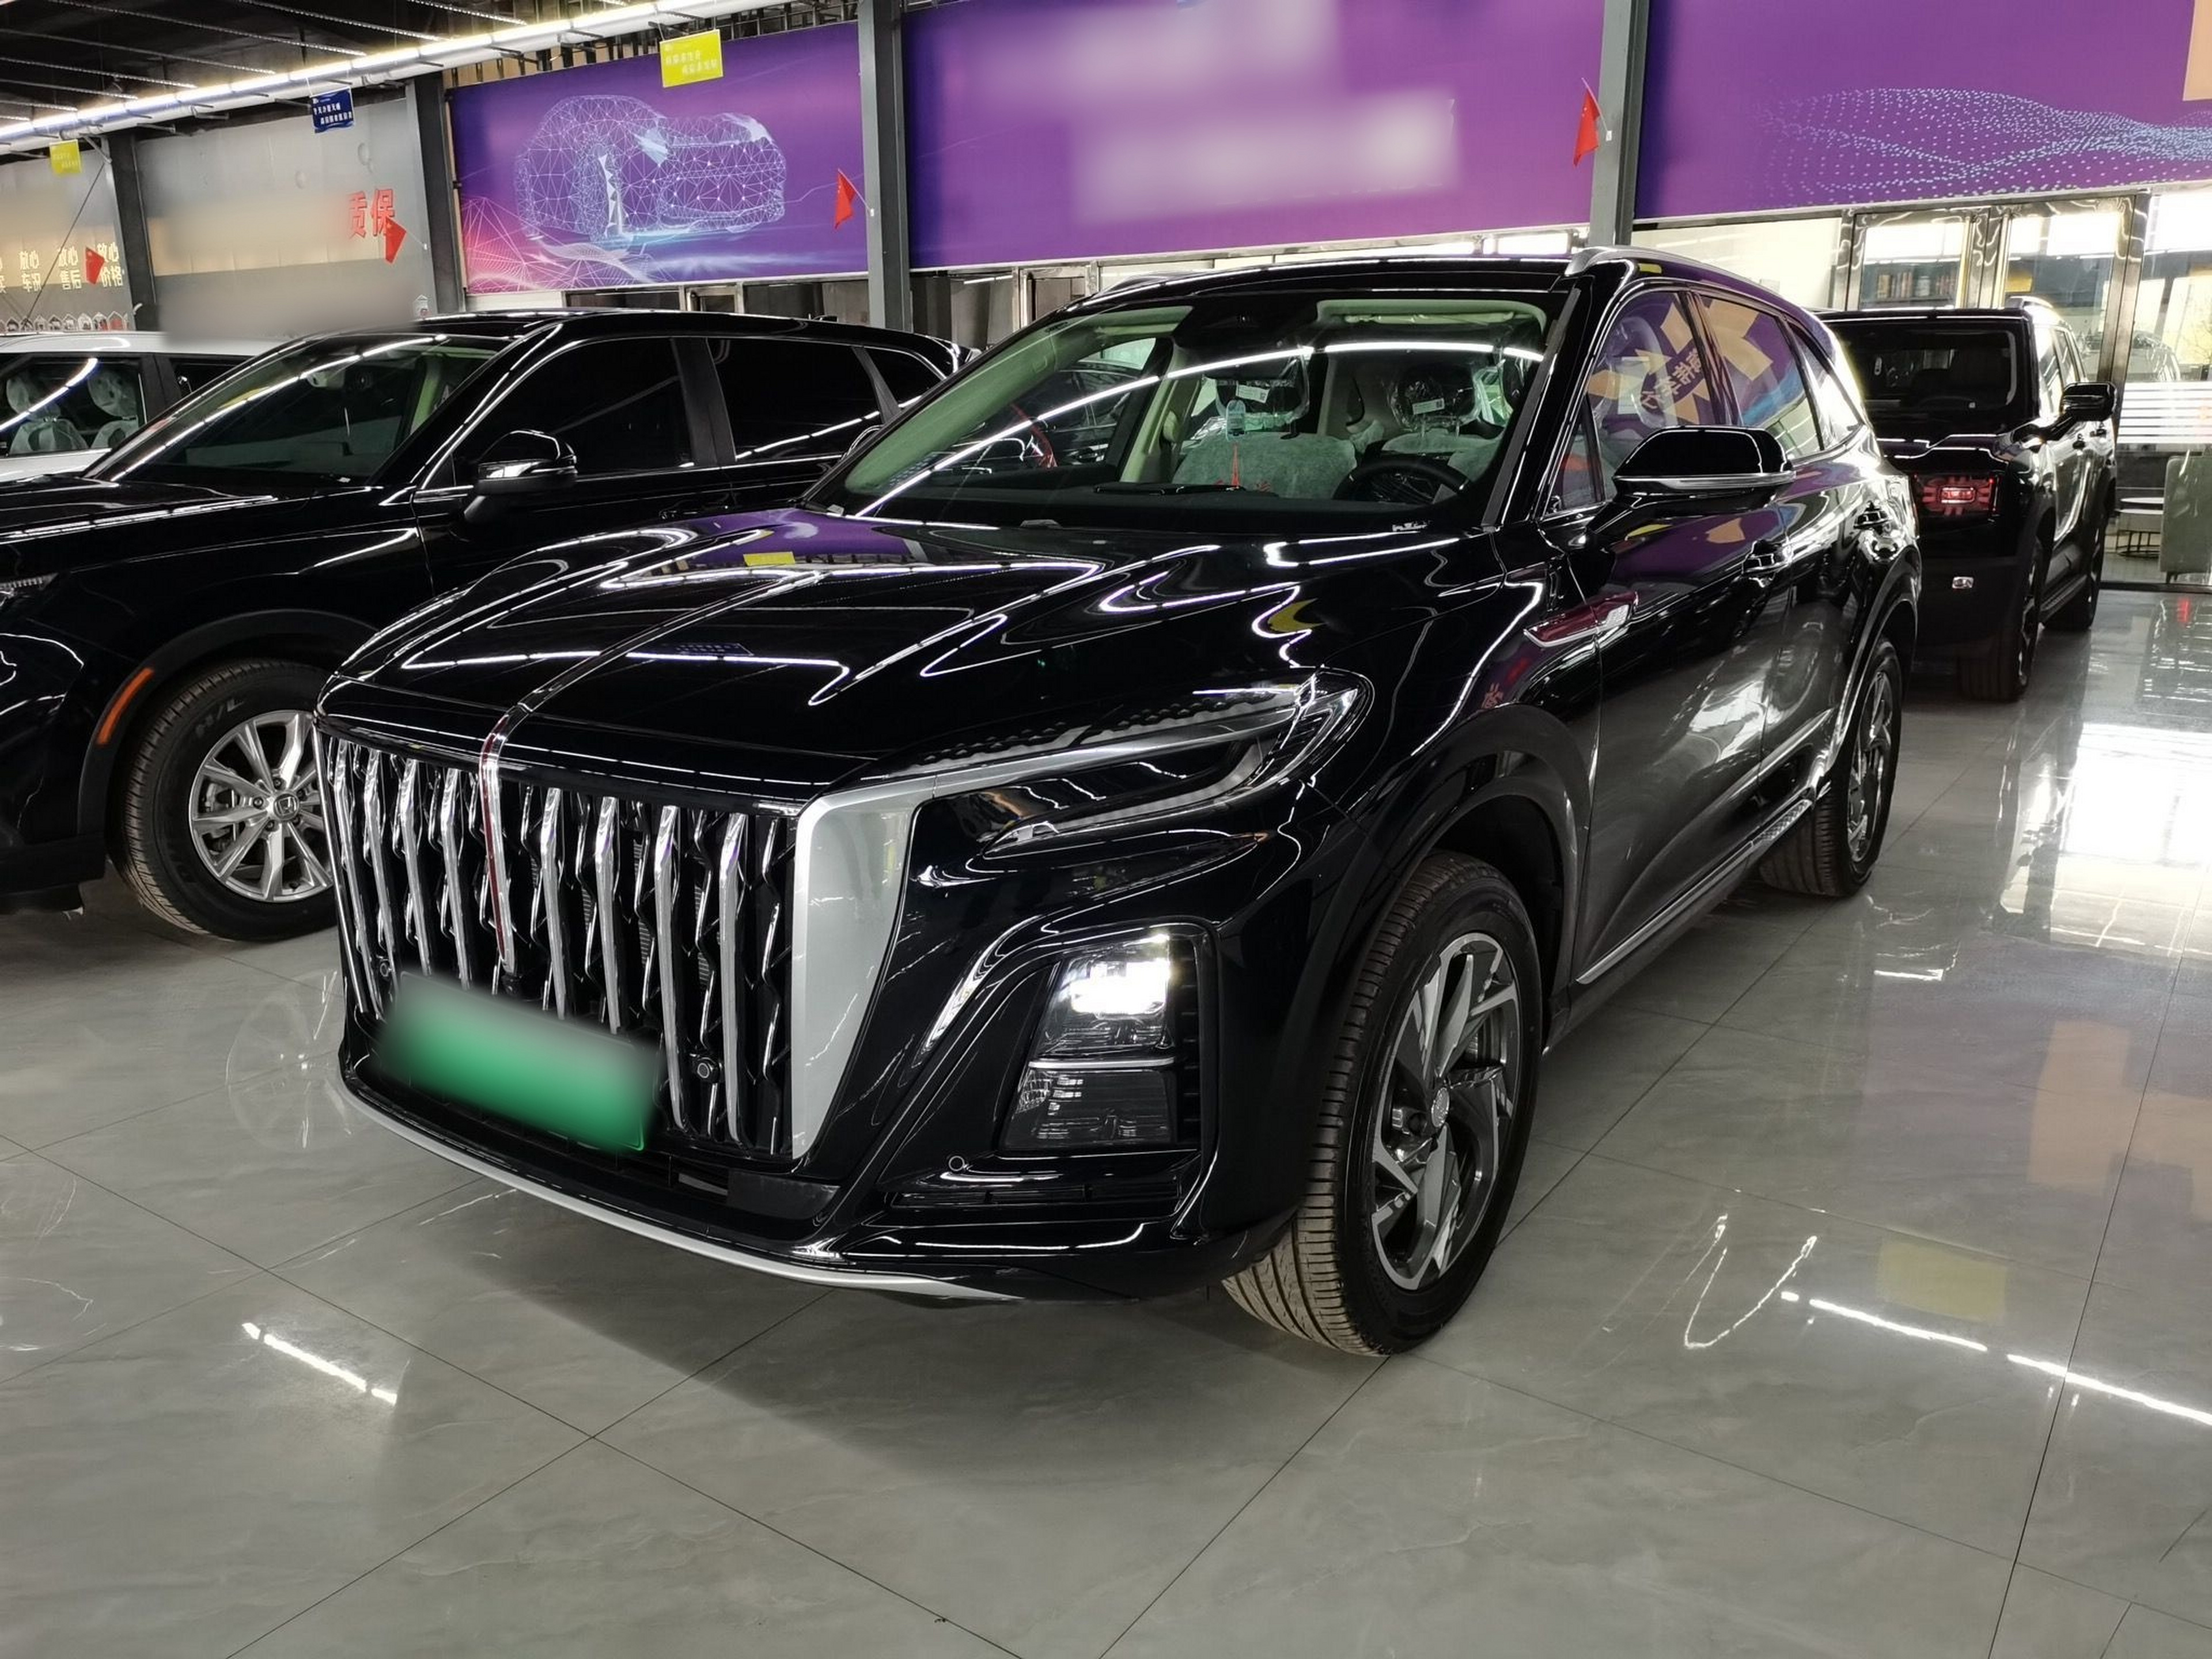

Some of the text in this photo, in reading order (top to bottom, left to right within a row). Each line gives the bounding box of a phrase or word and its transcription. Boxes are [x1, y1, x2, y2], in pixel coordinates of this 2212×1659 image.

[58, 246, 78, 267] 放心
[21, 272, 41, 292] 车况
[59, 269, 82, 290] 售后
[101, 266, 123, 287] 价格
